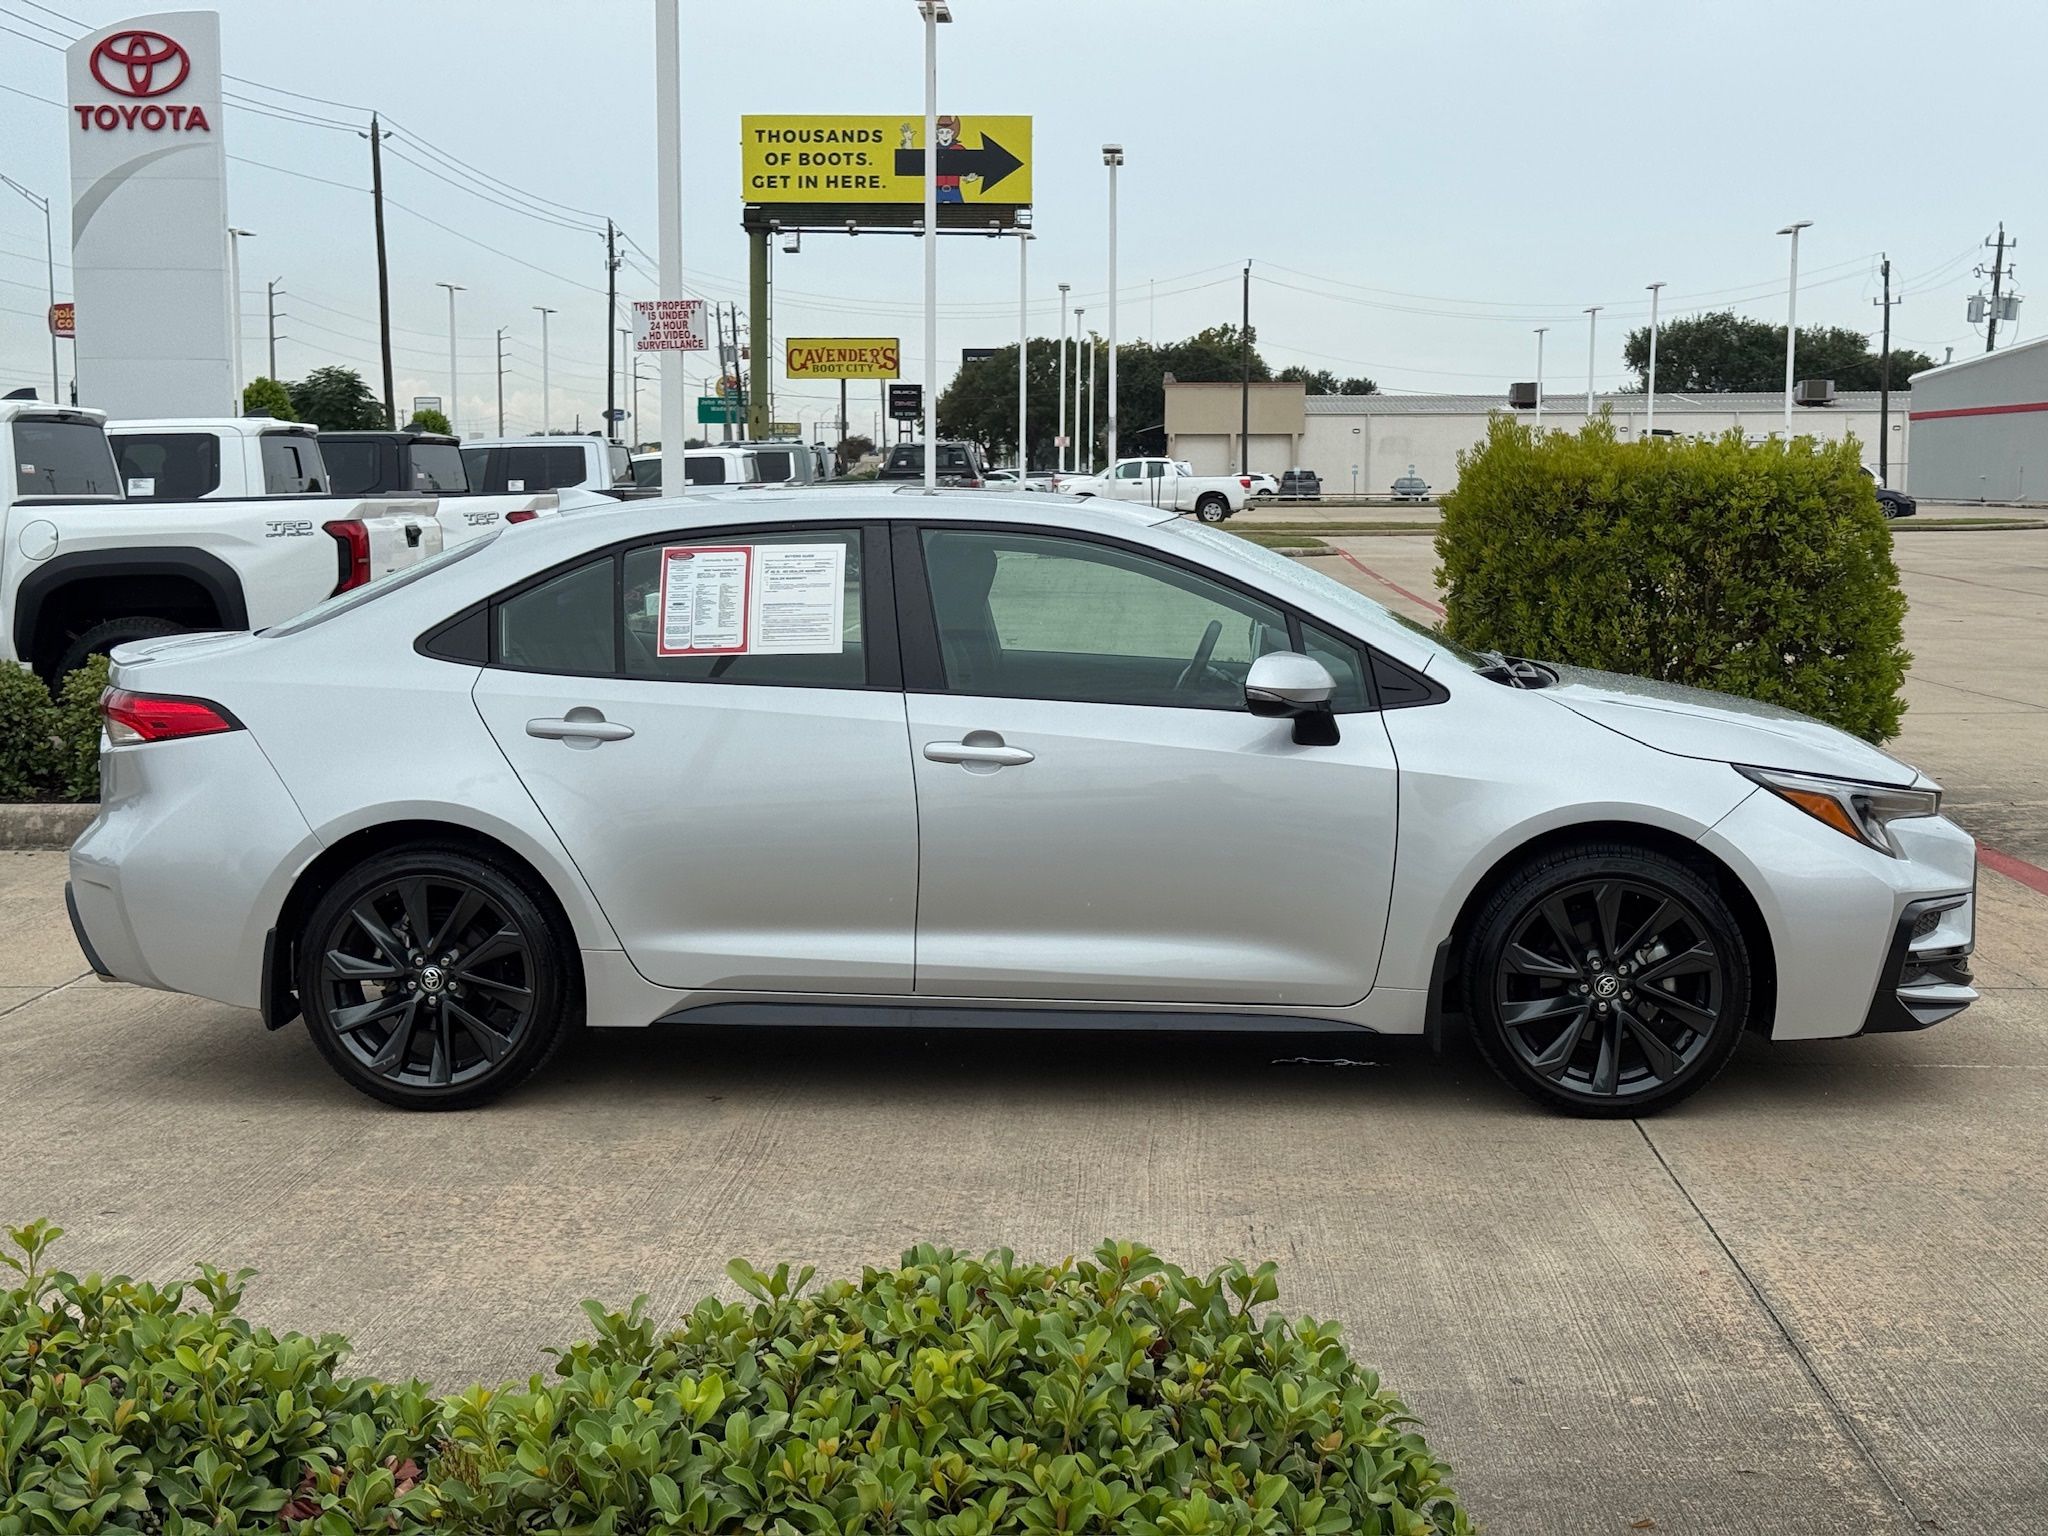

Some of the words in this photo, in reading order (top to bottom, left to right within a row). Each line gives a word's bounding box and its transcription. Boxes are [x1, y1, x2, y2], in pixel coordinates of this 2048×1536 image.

[74, 105, 211, 132] TOYOTA
[755, 129, 883, 143] THOUSANDS
[764, 152, 792, 166] OF
[799, 152, 873, 166] BOOTS.
[752, 175, 791, 189] GET
[798, 175, 818, 189] IN
[826, 175, 886, 189] HERE.
[634, 302, 654, 311] THIS
[656, 300, 703, 310] PROPERTY
[648, 311, 656, 320] IS
[659, 310, 689, 320] UNDER
[650, 322, 660, 330] 24
[663, 321, 688, 330] HOUR
[649, 331, 662, 340] HD
[664, 330, 690, 339] VIDEO
[637, 339, 704, 350] SURVEILLANCE
[789, 346, 897, 371] CAVENDER'S
[813, 364, 844, 373] BOOT
[844, 364, 874, 373] CITY
[463, 511, 500, 523] TRD
[265, 520, 313, 533] TRD
